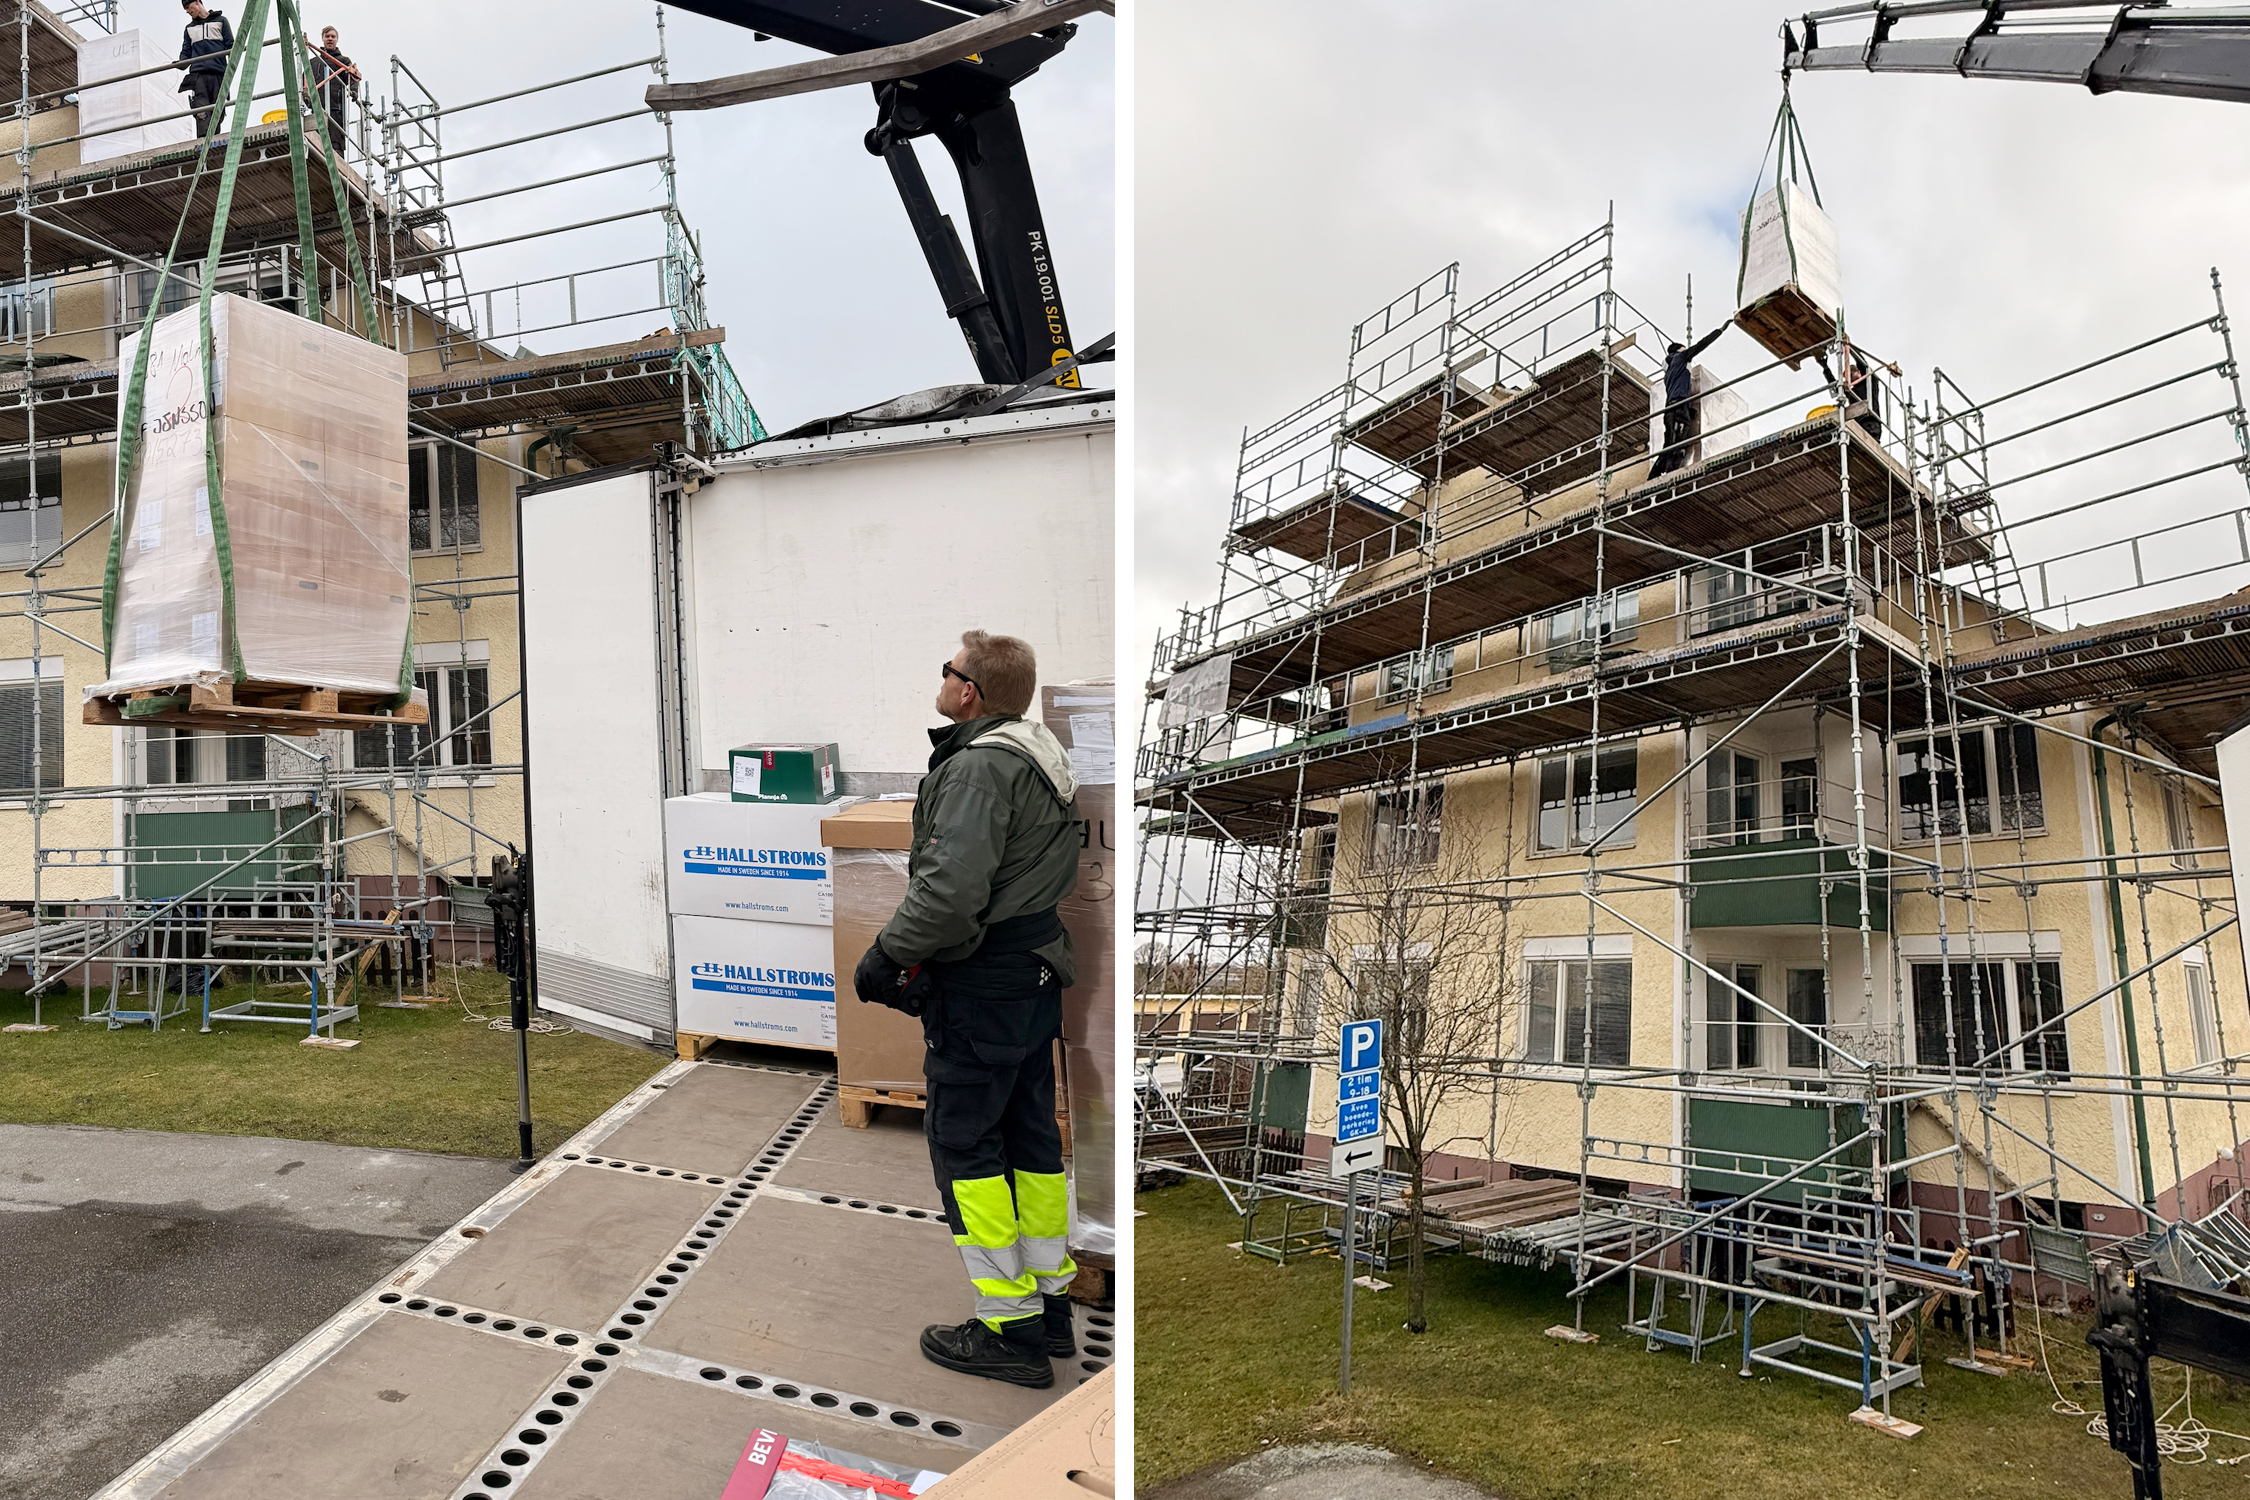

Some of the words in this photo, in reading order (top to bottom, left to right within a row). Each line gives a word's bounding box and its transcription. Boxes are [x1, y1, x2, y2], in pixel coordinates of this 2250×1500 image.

[1028, 230, 1044, 252] PK
[1033, 255, 1056, 303] 19.001
[716, 846, 827, 867] HALLSTRÖMS
[717, 866, 732, 874] MADE
[760, 869, 775, 877] SINCE
[725, 901, 789, 912] www.hallstroms.com
[724, 964, 835, 987] HALLSTRÖMS
[725, 984, 740, 992] MADE
[746, 985, 768, 994] SWEDEN
[769, 988, 784, 996] SINCE
[784, 989, 798, 997] 1914
[734, 1020, 799, 1033] www.hallstroms.com
[1351, 1026, 1375, 1068] P
[1348, 1077, 1354, 1087] 2
[1357, 1074, 1372, 1085] tim
[1349, 1086, 1370, 1098] 9-18
[1350, 1103, 1368, 1112] Även
[1344, 1111, 1374, 1122] boende-
[1341, 1117, 1376, 1133] parkering
